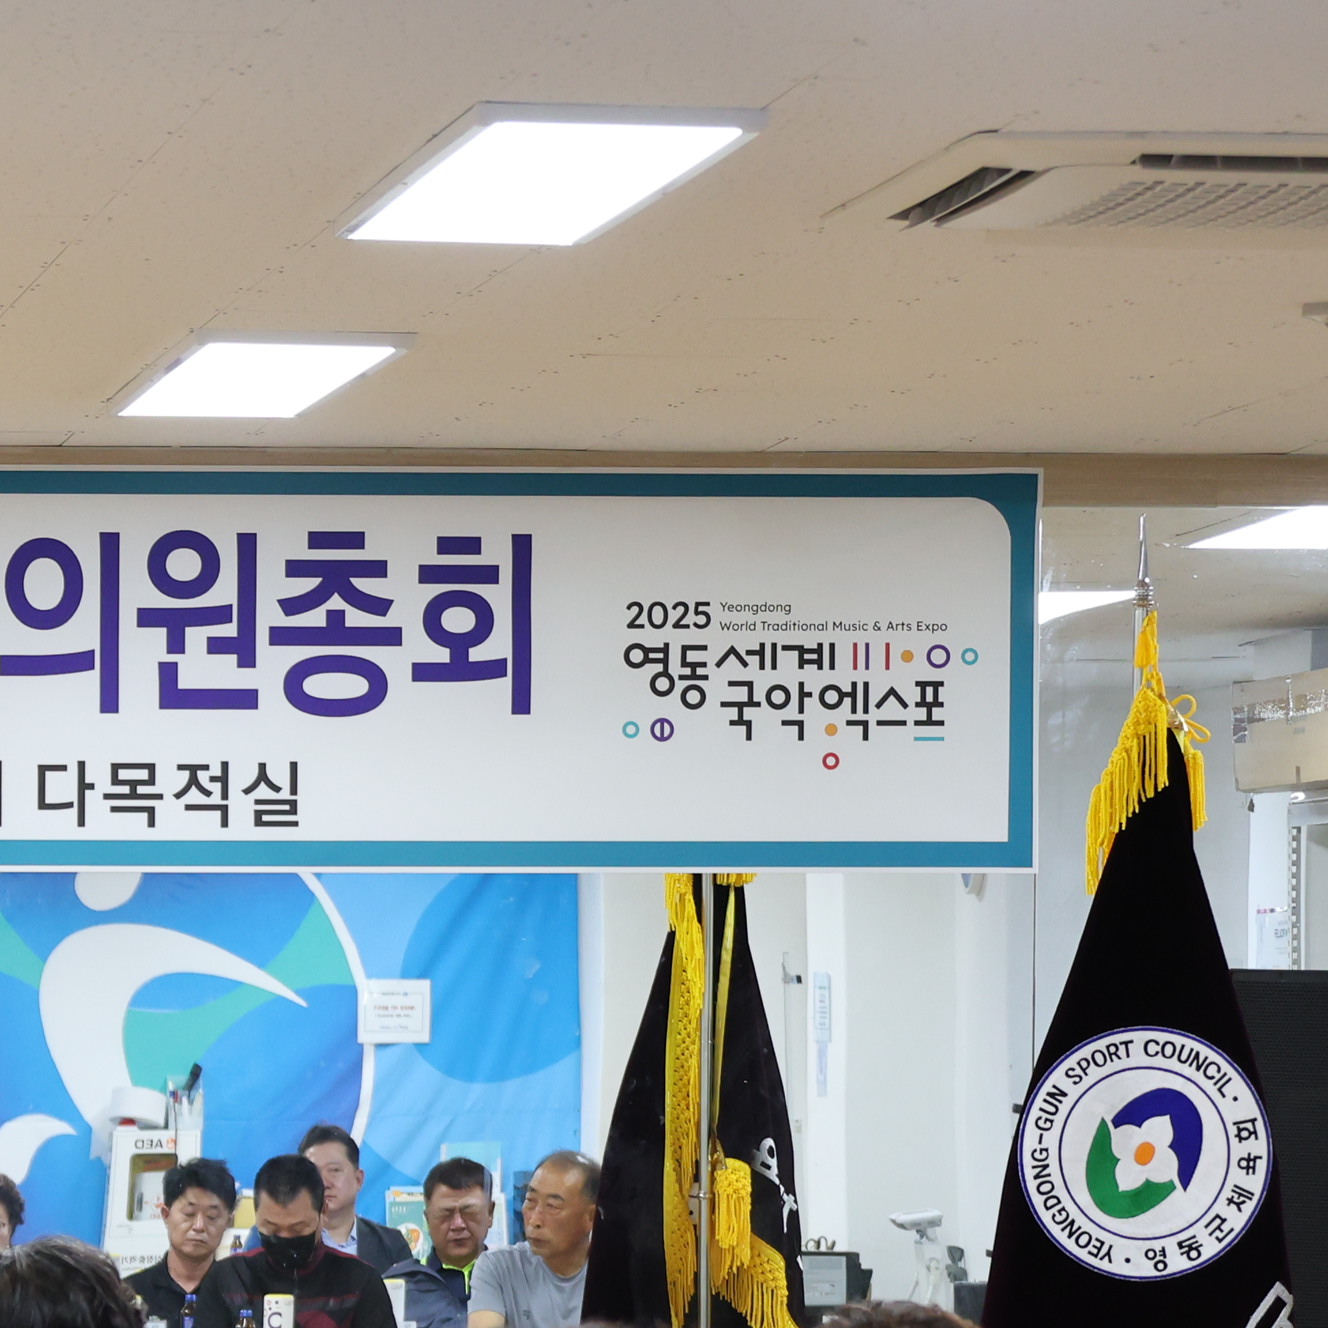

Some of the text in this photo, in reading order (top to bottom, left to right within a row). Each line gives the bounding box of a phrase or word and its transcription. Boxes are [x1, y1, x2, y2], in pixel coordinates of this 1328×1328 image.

[625, 600, 712, 630] 2025
[719, 601, 792, 616] Yeongdong
[719, 619, 948, 635] World Traditional Music & Arts Expo
[623, 642, 836, 711] 영동세계
[719, 680, 945, 742] 국악엑스포
[38, 759, 301, 830] 다목적실
[1031, 1038, 1235, 1264] YEONGDONG-GUN SPORT COUNCIL
[1144, 1117, 1263, 1272] 영동군체육회
